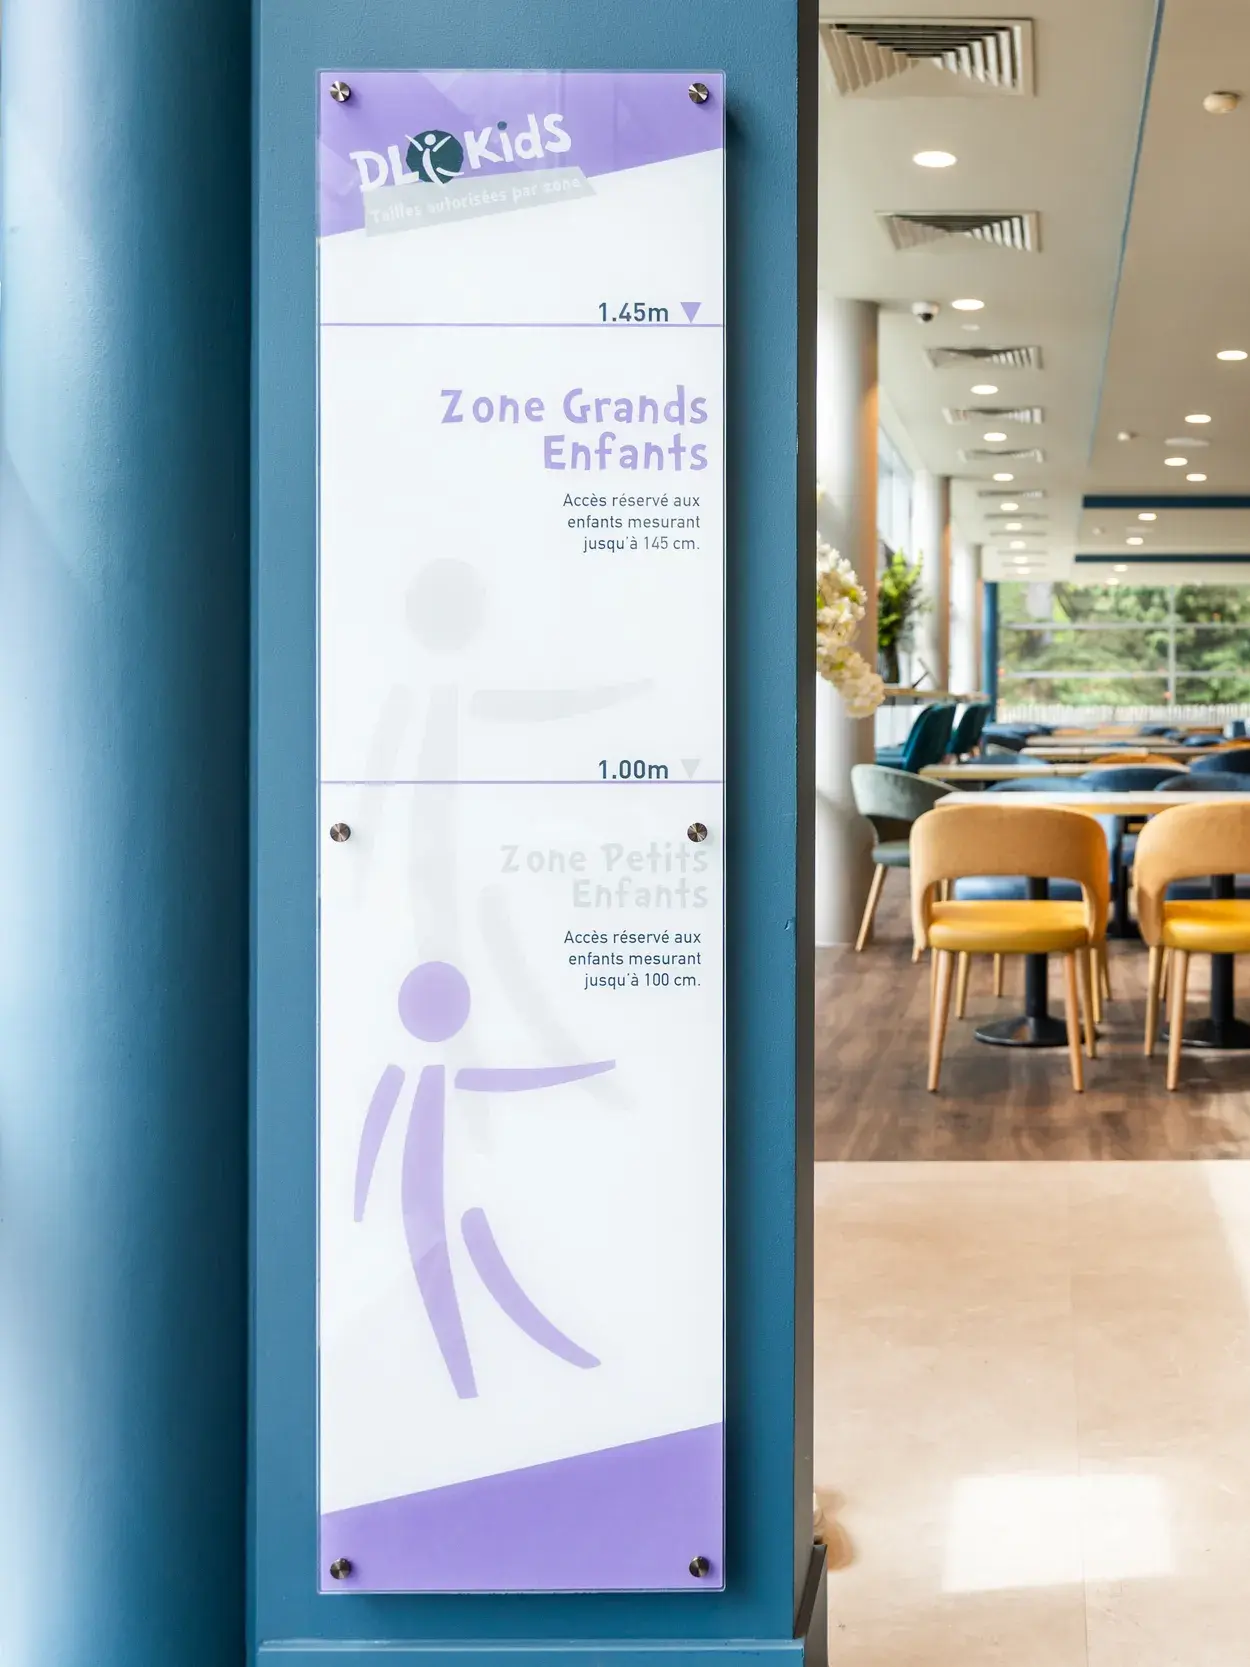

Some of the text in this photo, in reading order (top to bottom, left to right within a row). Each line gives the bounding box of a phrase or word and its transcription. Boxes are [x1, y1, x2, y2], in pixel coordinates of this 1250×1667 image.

[369, 177, 582, 225] Tailles autorisées par zone
[598, 302, 669, 322] 1.45m
[440, 384, 708, 426] Zone Grands
[543, 431, 708, 471] Enfants
[563, 493, 700, 507] Accès réservé aux
[567, 514, 700, 529] enfants mesurant
[583, 536, 700, 554] jusqu'à 145 cm.
[598, 759, 669, 780] 1.00m
[500, 841, 708, 873] Zone Petits
[572, 877, 708, 909] Enfants
[564, 930, 701, 944] Accès réservé aux
[568, 952, 701, 966] enfants mesurant
[584, 973, 701, 991] jusqu'à 100 cm.
